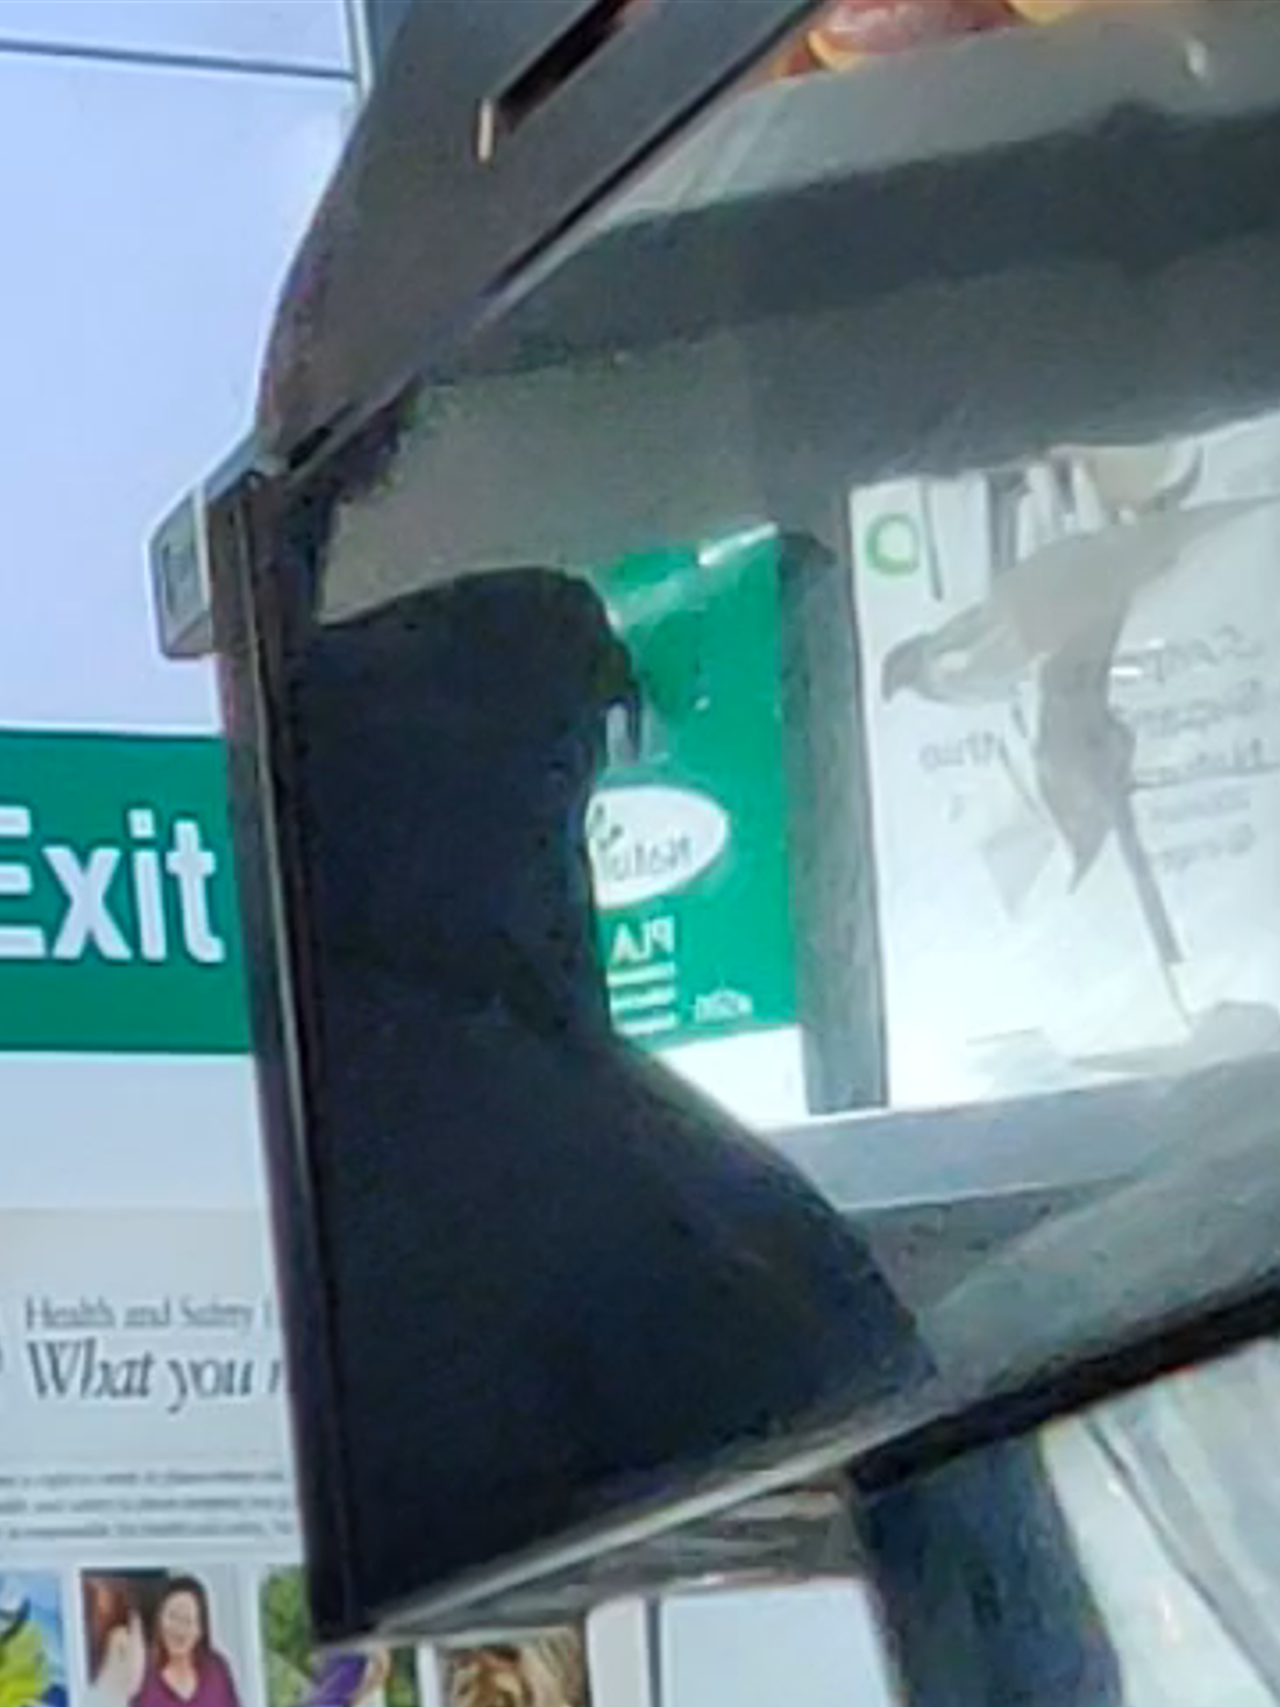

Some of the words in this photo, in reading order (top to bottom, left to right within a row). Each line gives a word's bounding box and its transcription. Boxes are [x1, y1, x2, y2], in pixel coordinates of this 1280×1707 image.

[122, 1296, 172, 1329] and
[25, 1336, 155, 1400] What
[166, 1357, 253, 1416] you
